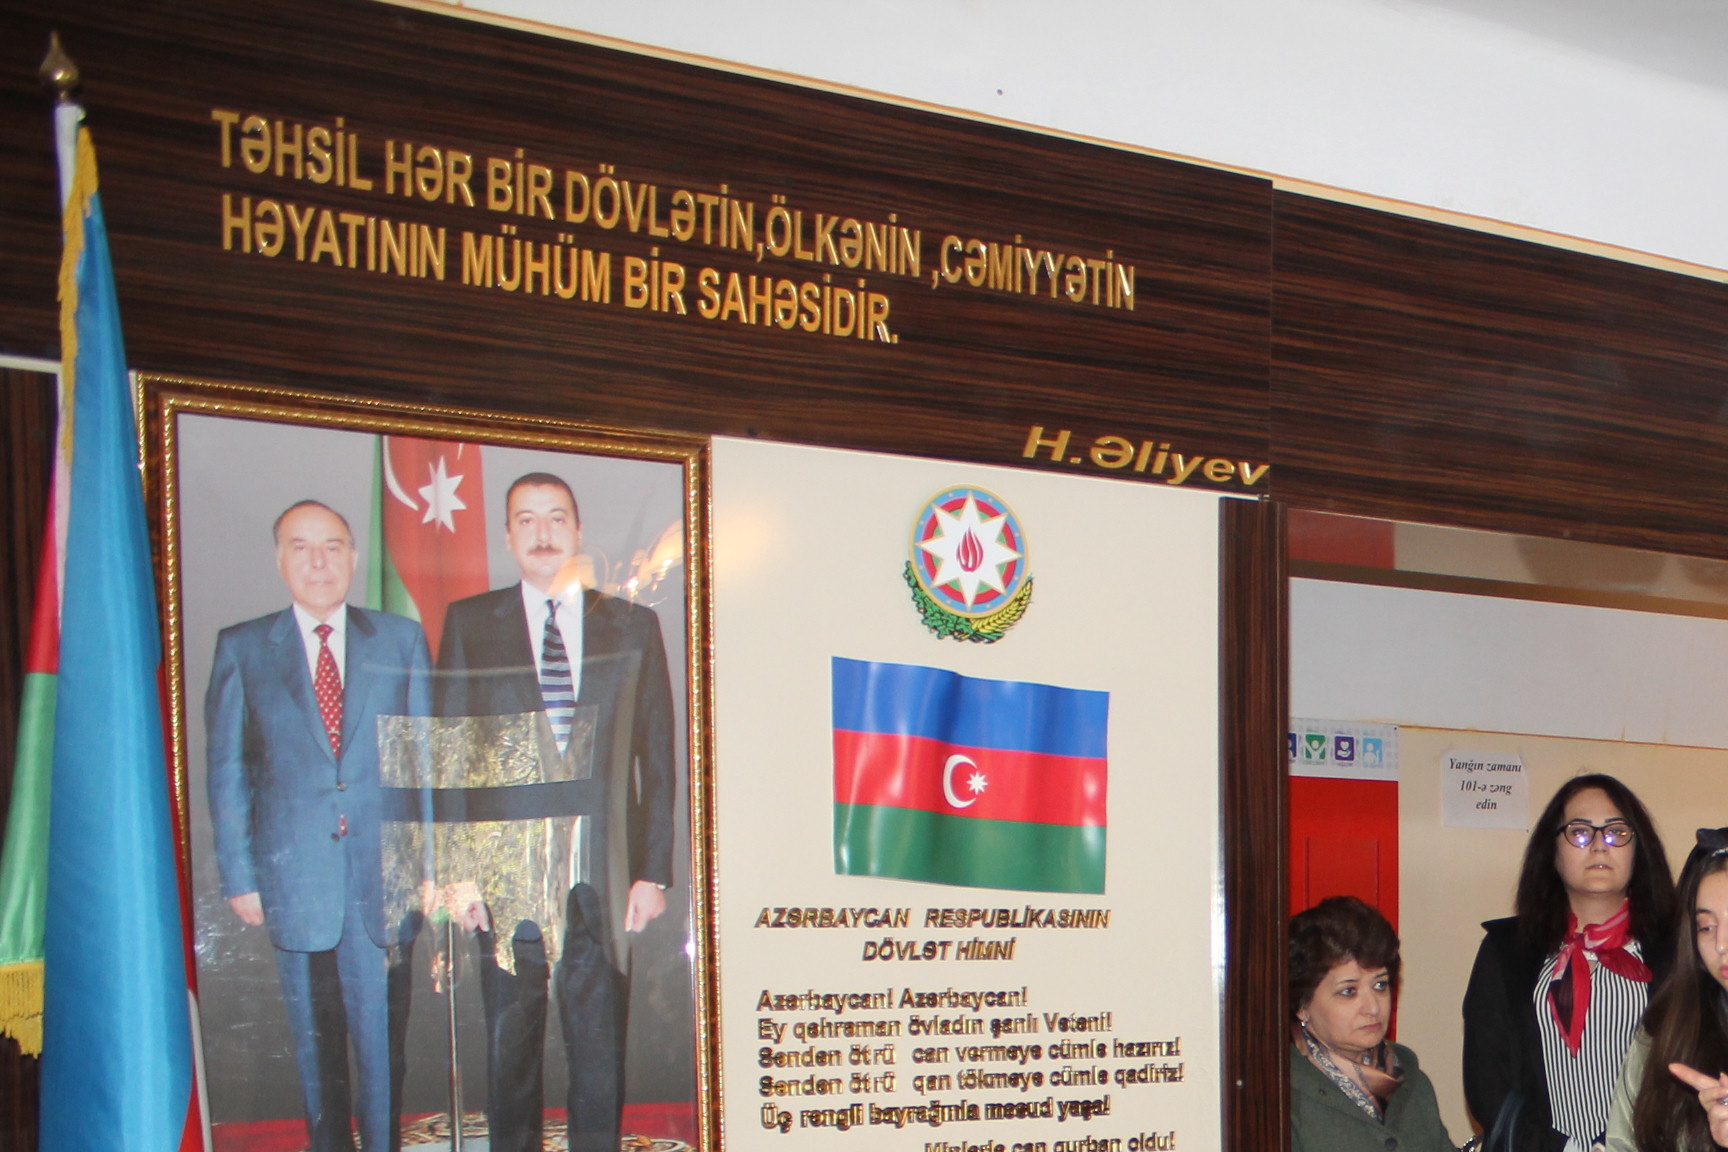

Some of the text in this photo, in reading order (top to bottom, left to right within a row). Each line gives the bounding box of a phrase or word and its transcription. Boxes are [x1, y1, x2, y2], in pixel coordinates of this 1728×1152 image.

[211, 109, 373, 191] TƏHSİL
[384, 139, 475, 207] HƏR
[487, 147, 555, 220] BİR
[221, 194, 899, 344] HƏYATININ MÜHÜM BİR SAHƏSİDİR.
[1022, 425, 1270, 487] H.Əliyev
[1450, 758, 1522, 773] Yanğın zamanı
[1461, 780, 1512, 796] 101-ə zəng
[1476, 798, 1497, 810] edin
[754, 905, 1112, 929] AZƏRBAYCAN RESPUBLİKASININ
[862, 937, 1017, 961] DÖVLƏT HİMNİ
[756, 986, 1028, 1014] Azərbaycan! Azərbaycan!
[758, 1018, 788, 1044] Ey
[908, 1014, 984, 1036] övladın
[990, 1013, 1039, 1038] şanlı
[912, 1047, 950, 1063] can
[912, 1073, 951, 1096] qan
[761, 1102, 793, 1134] Üç
[1127, 1131, 1176, 1152] oldu!
